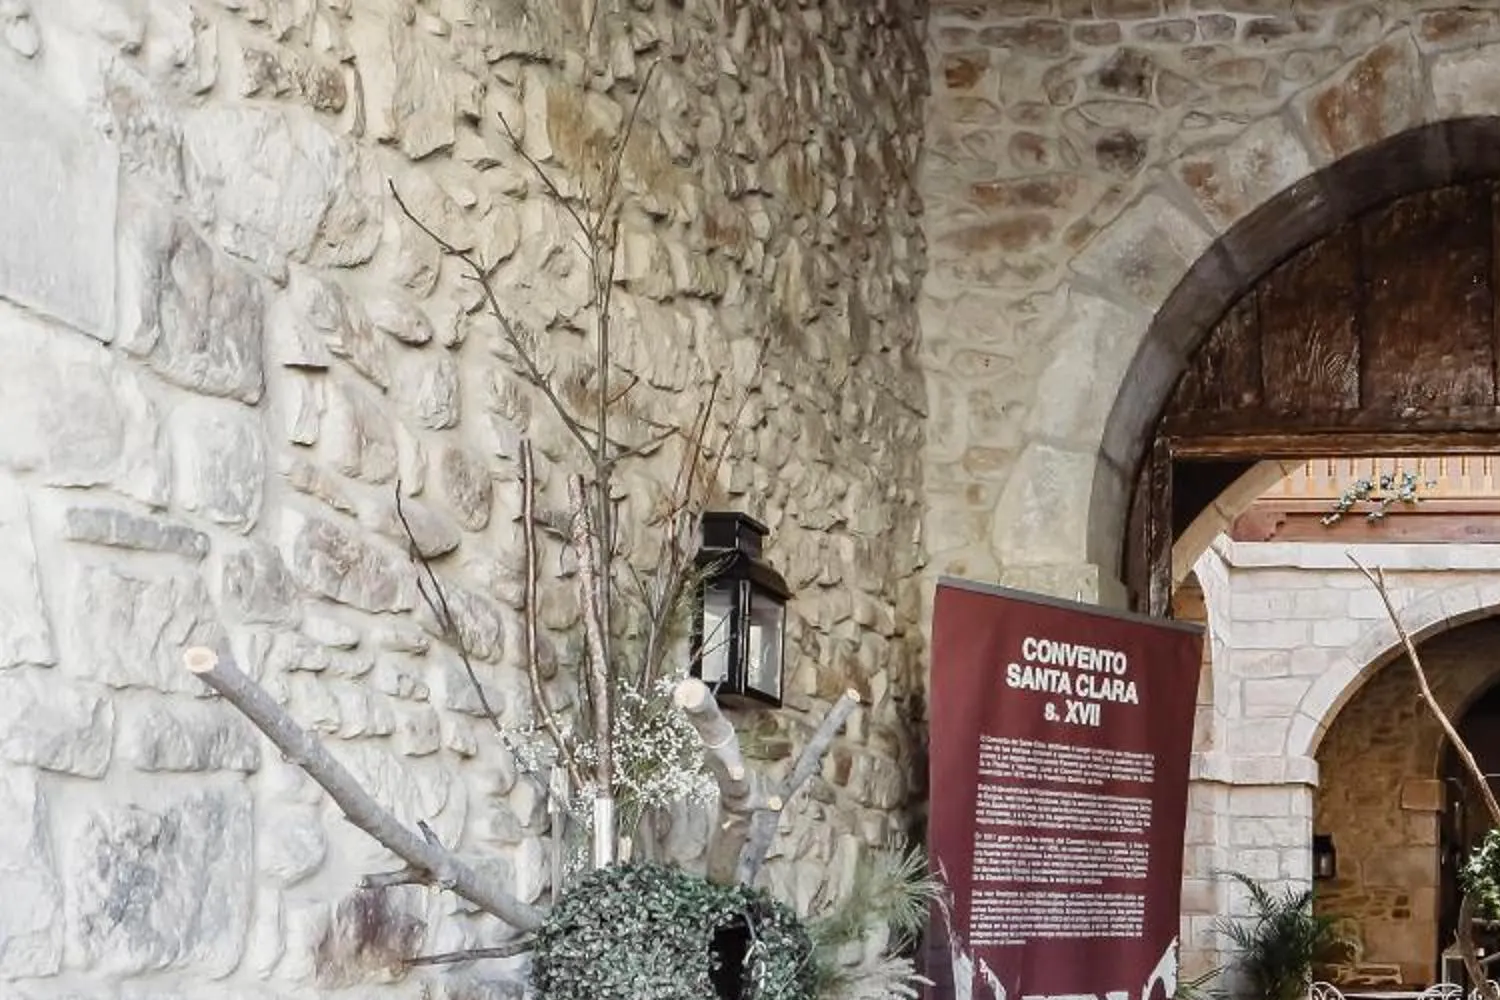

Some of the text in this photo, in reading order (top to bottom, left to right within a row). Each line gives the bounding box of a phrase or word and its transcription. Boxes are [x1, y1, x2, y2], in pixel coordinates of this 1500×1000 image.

[1022, 637, 1127, 674] CONVENTO
[1006, 663, 1139, 704] SANTA CLARA
[1065, 699, 1102, 727] XVII
